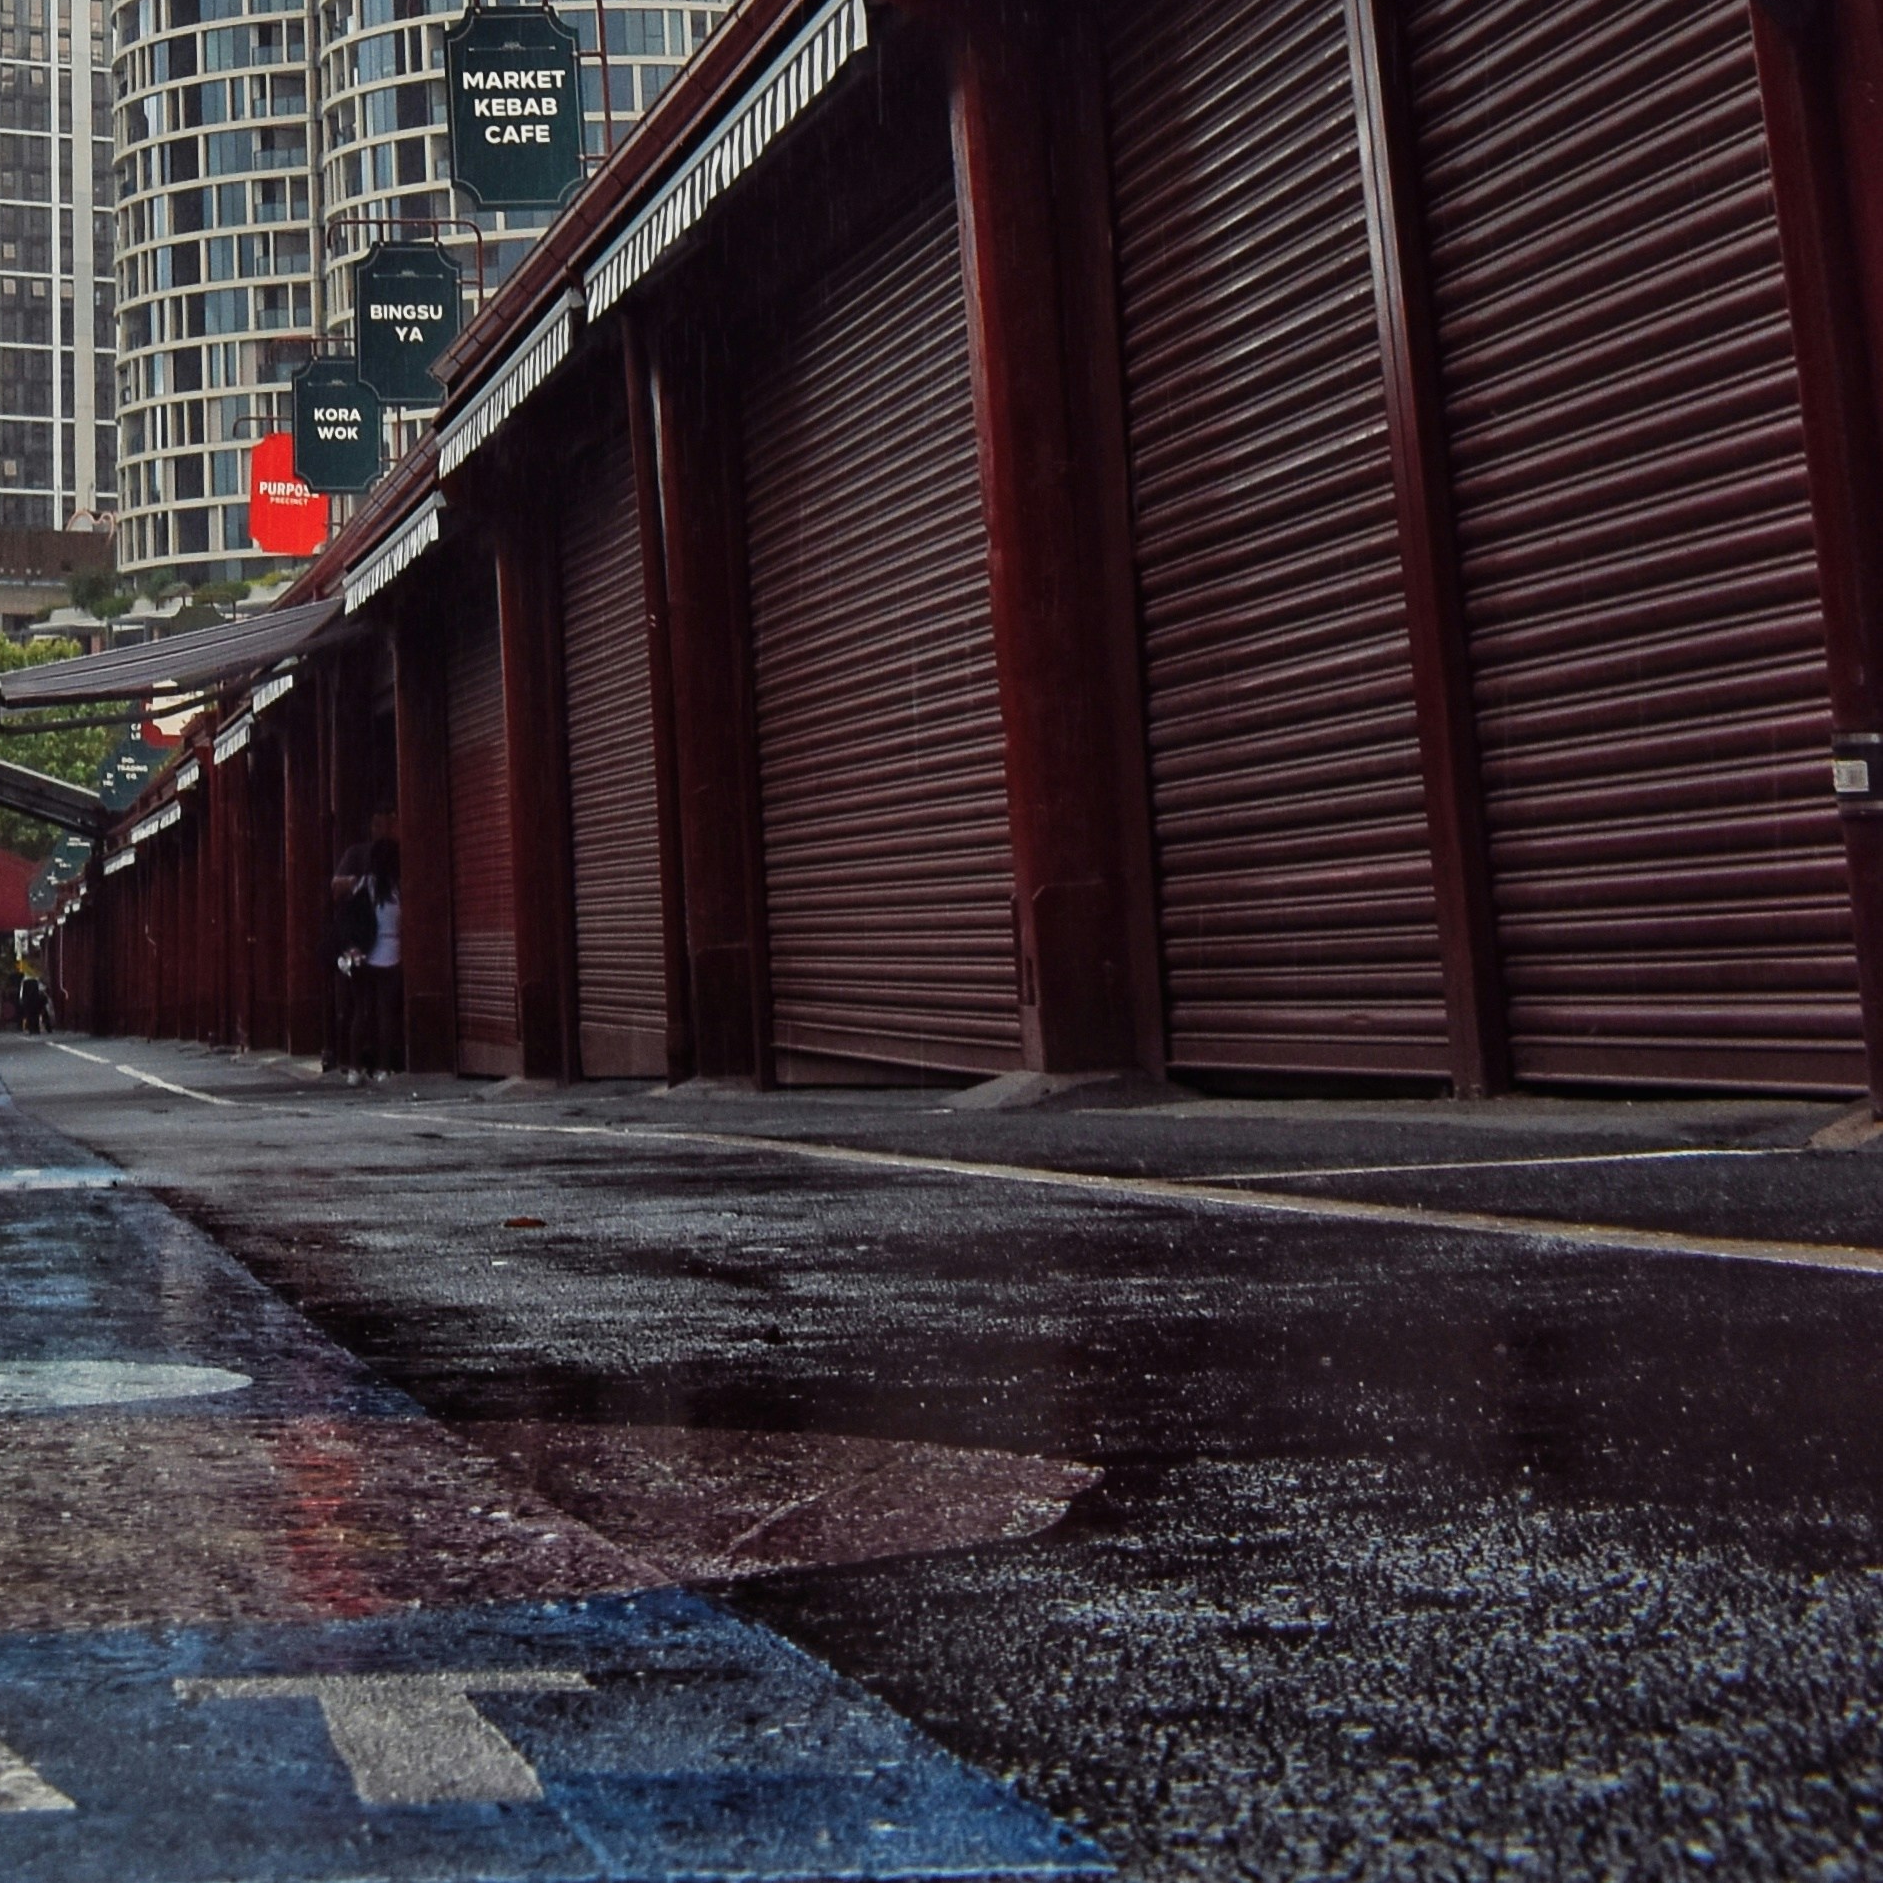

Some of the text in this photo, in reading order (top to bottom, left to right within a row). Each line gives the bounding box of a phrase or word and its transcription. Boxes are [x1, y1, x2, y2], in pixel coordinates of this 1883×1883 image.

[462, 70, 565, 89] MARKET
[474, 97, 558, 117] KEBAB
[485, 124, 550, 144] CAFE
[370, 304, 442, 320] BINGSU
[395, 326, 423, 342] YA
[314, 407, 361, 421] KORA
[317, 426, 358, 440] WOK
